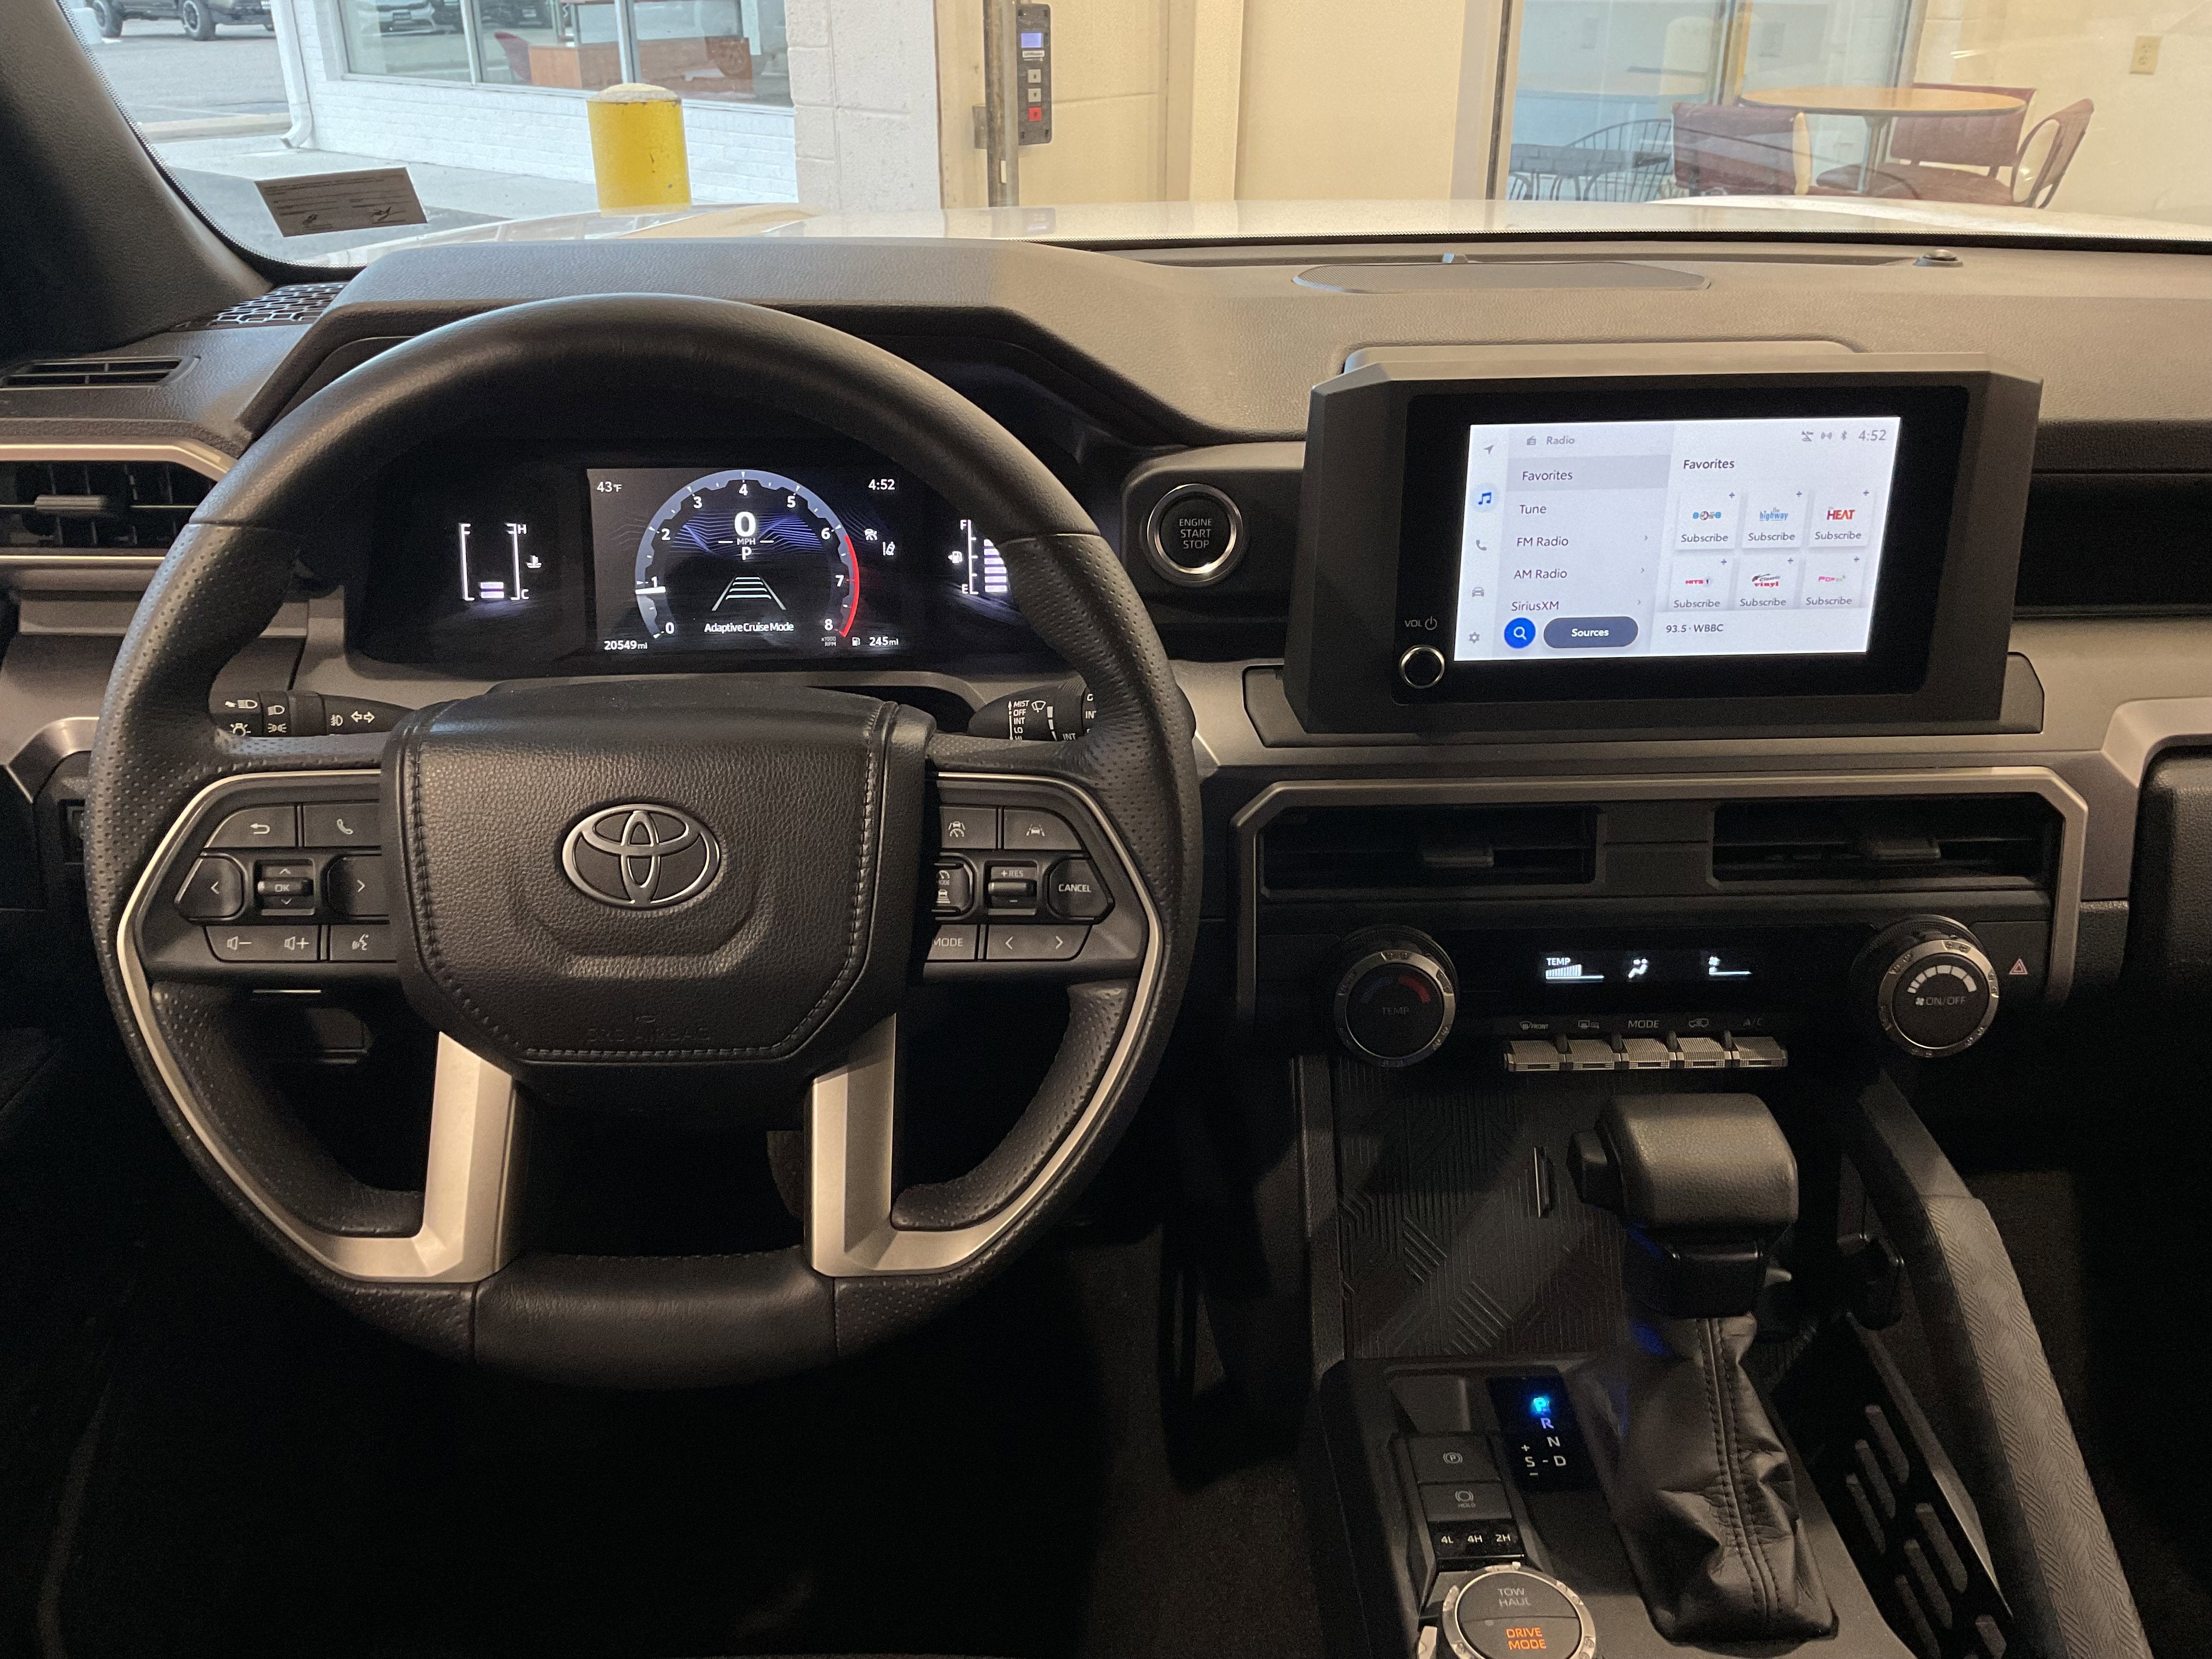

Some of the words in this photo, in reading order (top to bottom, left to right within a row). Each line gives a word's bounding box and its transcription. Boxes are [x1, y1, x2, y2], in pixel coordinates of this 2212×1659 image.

[1546, 436, 1575, 445] Radio
[1858, 430, 1887, 441] 4:52
[1683, 459, 1735, 469] Favorites
[1522, 471, 1573, 481] Favorites
[868, 479, 895, 490] 4:52
[739, 484, 748, 496] 4
[693, 496, 703, 509] 3
[787, 495, 796, 508] 5
[1519, 504, 1547, 515] Tune
[1759, 510, 1788, 521] highway
[1826, 510, 1855, 521] HEAT
[734, 511, 755, 537] 0
[960, 520, 967, 530] F
[1180, 518, 1212, 527] ENGINE
[661, 528, 670, 540] 2
[821, 528, 831, 540] 6
[1180, 529, 1211, 538] START
[1681, 533, 1729, 543] Subscribe
[1748, 532, 1795, 542] Subscribe
[1814, 531, 1861, 540] Subscribe
[1183, 540, 1210, 549] STOP
[1516, 538, 1533, 547] FM
[1537, 537, 1568, 547] Radio
[741, 546, 752, 560] P
[1514, 570, 1532, 579] AM
[1536, 569, 1567, 579] Radio
[651, 576, 658, 588] 1
[835, 574, 844, 586] 7
[961, 583, 969, 594] E
[521, 589, 529, 600] C
[1673, 599, 1720, 609] Subscribe
[1740, 598, 1787, 607] Subscribe
[1805, 596, 1853, 606] Subscribe
[1511, 601, 1559, 612] SiriusXM
[665, 622, 675, 634] 0
[704, 622, 743, 633] Adaptive
[743, 622, 769, 631] Cruise
[770, 622, 794, 631] Mode
[824, 618, 833, 631] 8
[1666, 624, 1687, 634] 93.5
[1694, 624, 1724, 633] WBBC
[1571, 628, 1609, 637] Sources
[1013, 699, 1030, 708] MIST
[1058, 883, 1092, 893] CANCEL
[933, 938, 963, 947] MODE
[1547, 957, 1571, 966] TEMP
[1926, 996, 1966, 1006] ON/OFF
[1382, 1007, 1409, 1015] TEMP
[1628, 1020, 1659, 1029] MODE
[1743, 1018, 1763, 1027] A/C
[1541, 1418, 1554, 1429] R
[1547, 1436, 1560, 1447] N
[1525, 1457, 1536, 1468] S
[1554, 1455, 1566, 1466] D
[1467, 1535, 1483, 1543] 4H
[1496, 1534, 1511, 1542] 2H
[1497, 1587, 1525, 1596] TOW
[1498, 1598, 1532, 1607] HAUL
[1506, 1627, 1542, 1638] DRIVE
[1508, 1639, 1547, 1650] MODE
